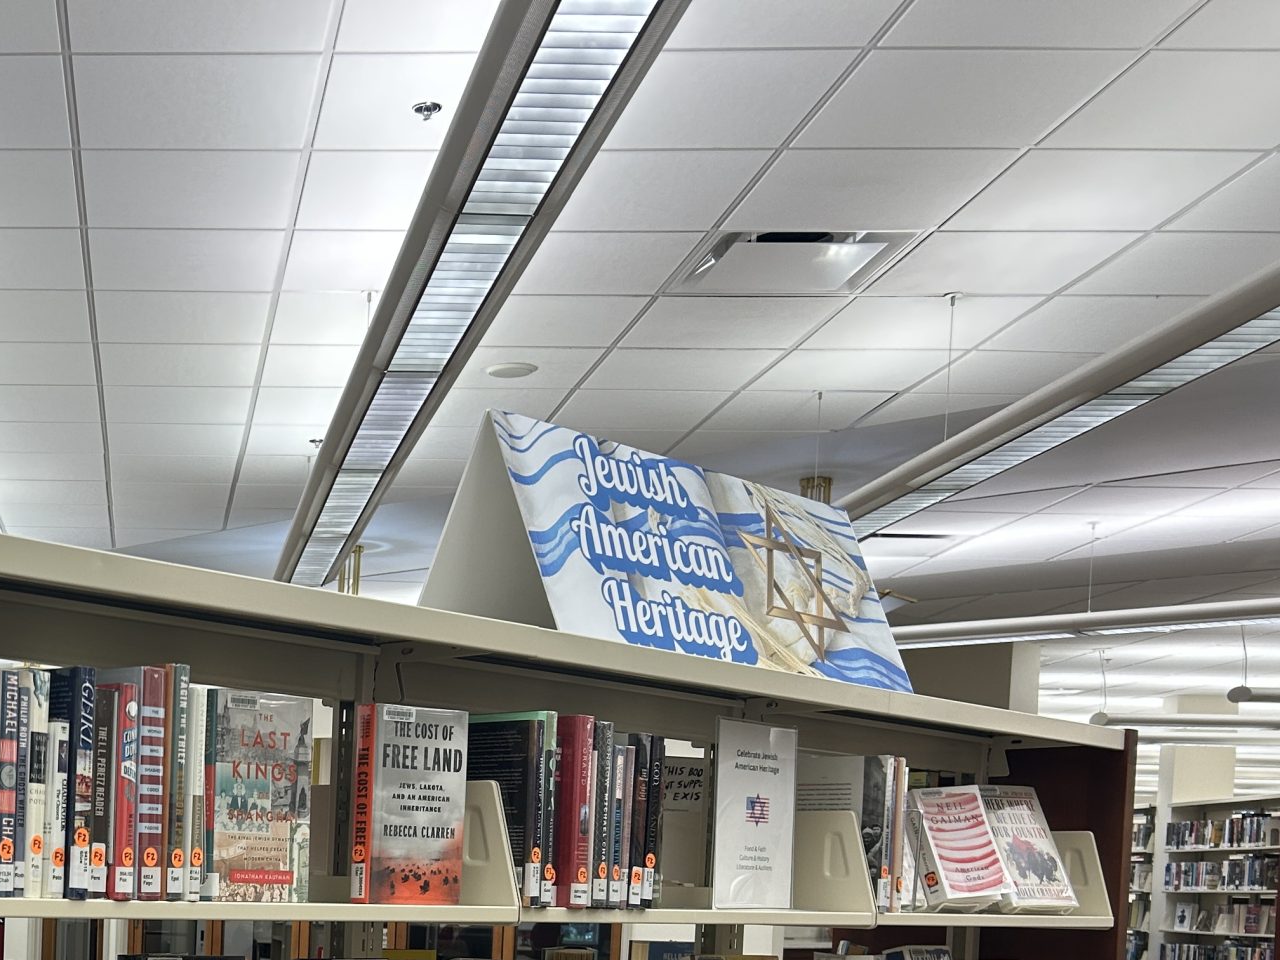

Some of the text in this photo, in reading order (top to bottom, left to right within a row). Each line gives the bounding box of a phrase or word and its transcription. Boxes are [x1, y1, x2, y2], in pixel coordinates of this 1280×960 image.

[574, 433, 688, 508] Jewish
[572, 505, 732, 582] American
[603, 577, 747, 660] Heritage
[259, 713, 273, 722] THE
[239, 729, 291, 749] LAST
[394, 722, 454, 741] THE COST OF
[382, 743, 462, 773] FREE LAND
[737, 749, 778, 760] Celebrate Jewish
[231, 760, 297, 784] KINGS
[735, 762, 758, 771] American
[936, 802, 966, 811] NEIL
[930, 814, 980, 825] GAIMAN
[383, 824, 455, 840] REBECCA CLARREN
